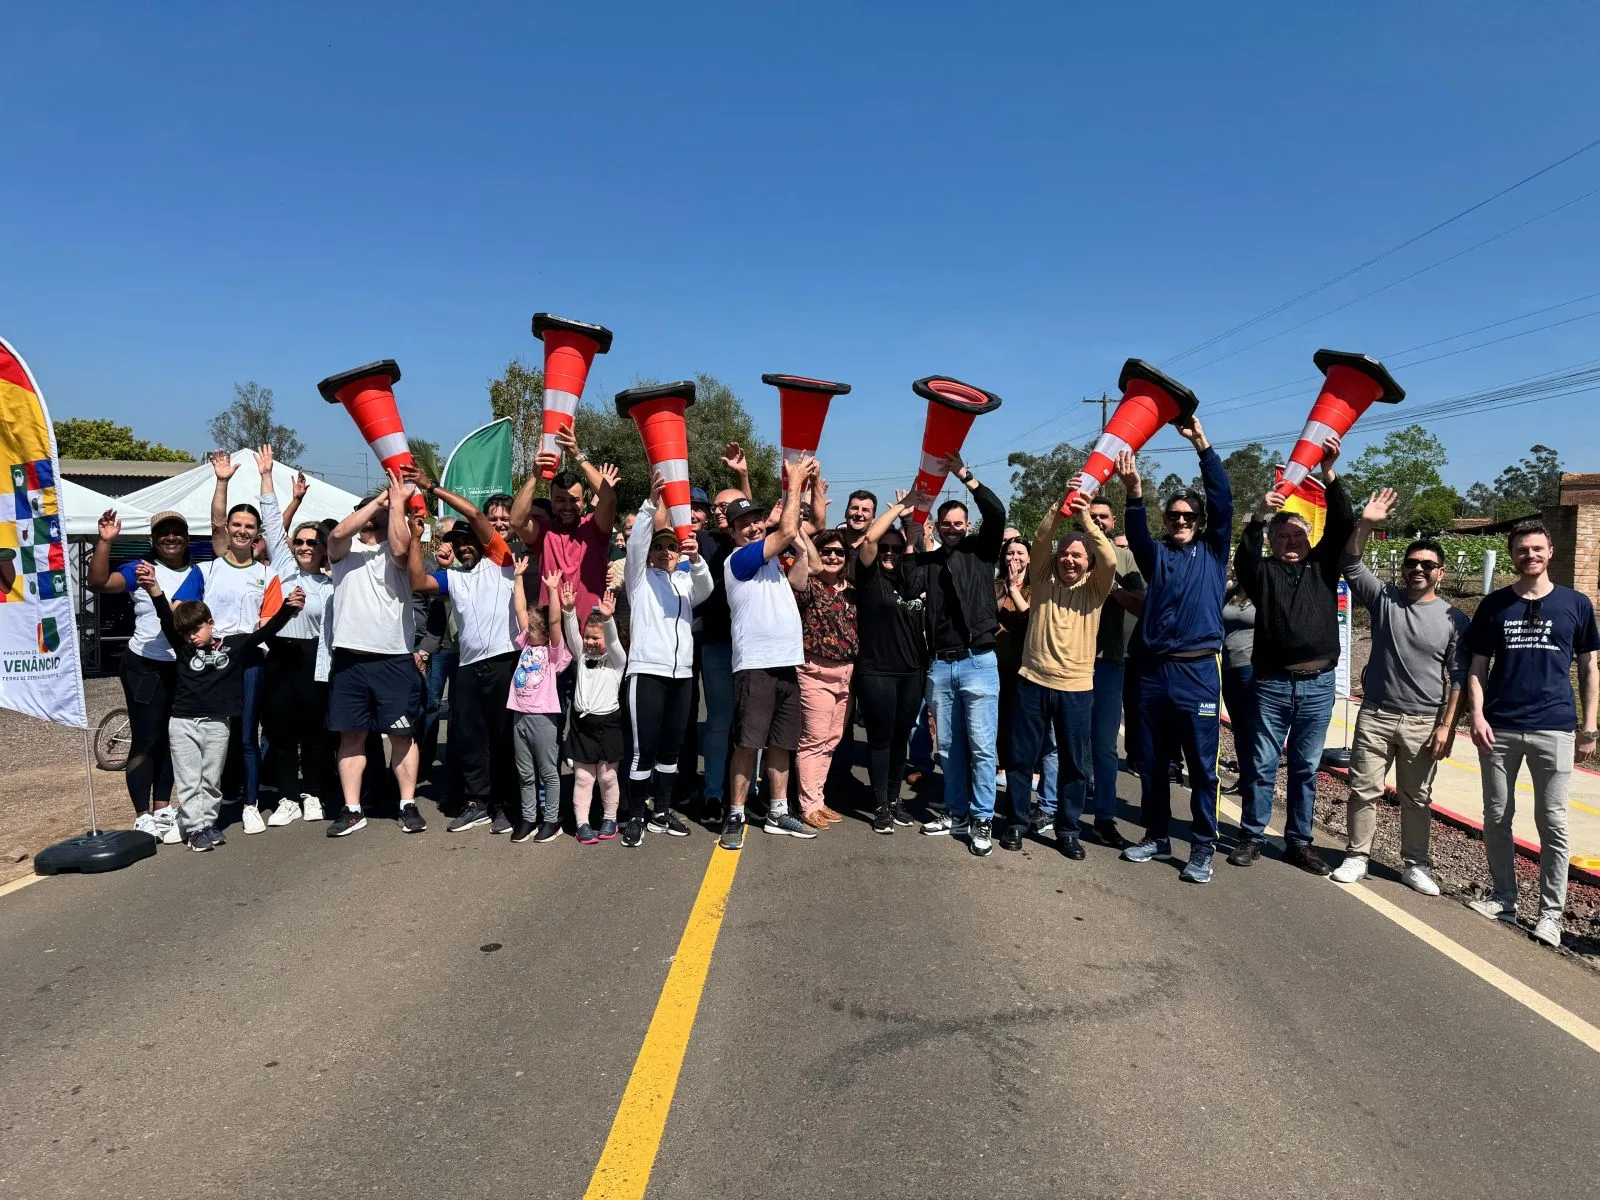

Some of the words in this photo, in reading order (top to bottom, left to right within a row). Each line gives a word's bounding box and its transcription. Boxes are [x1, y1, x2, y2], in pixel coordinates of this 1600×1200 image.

[1503, 619, 1544, 627] Inovaão
[1503, 626, 1542, 634] Trabalho
[1543, 627, 1551, 635] &
[1504, 635, 1539, 643] Turismo
[1540, 635, 1548, 643] &
[3, 655, 61, 673] VENÂNCIO
